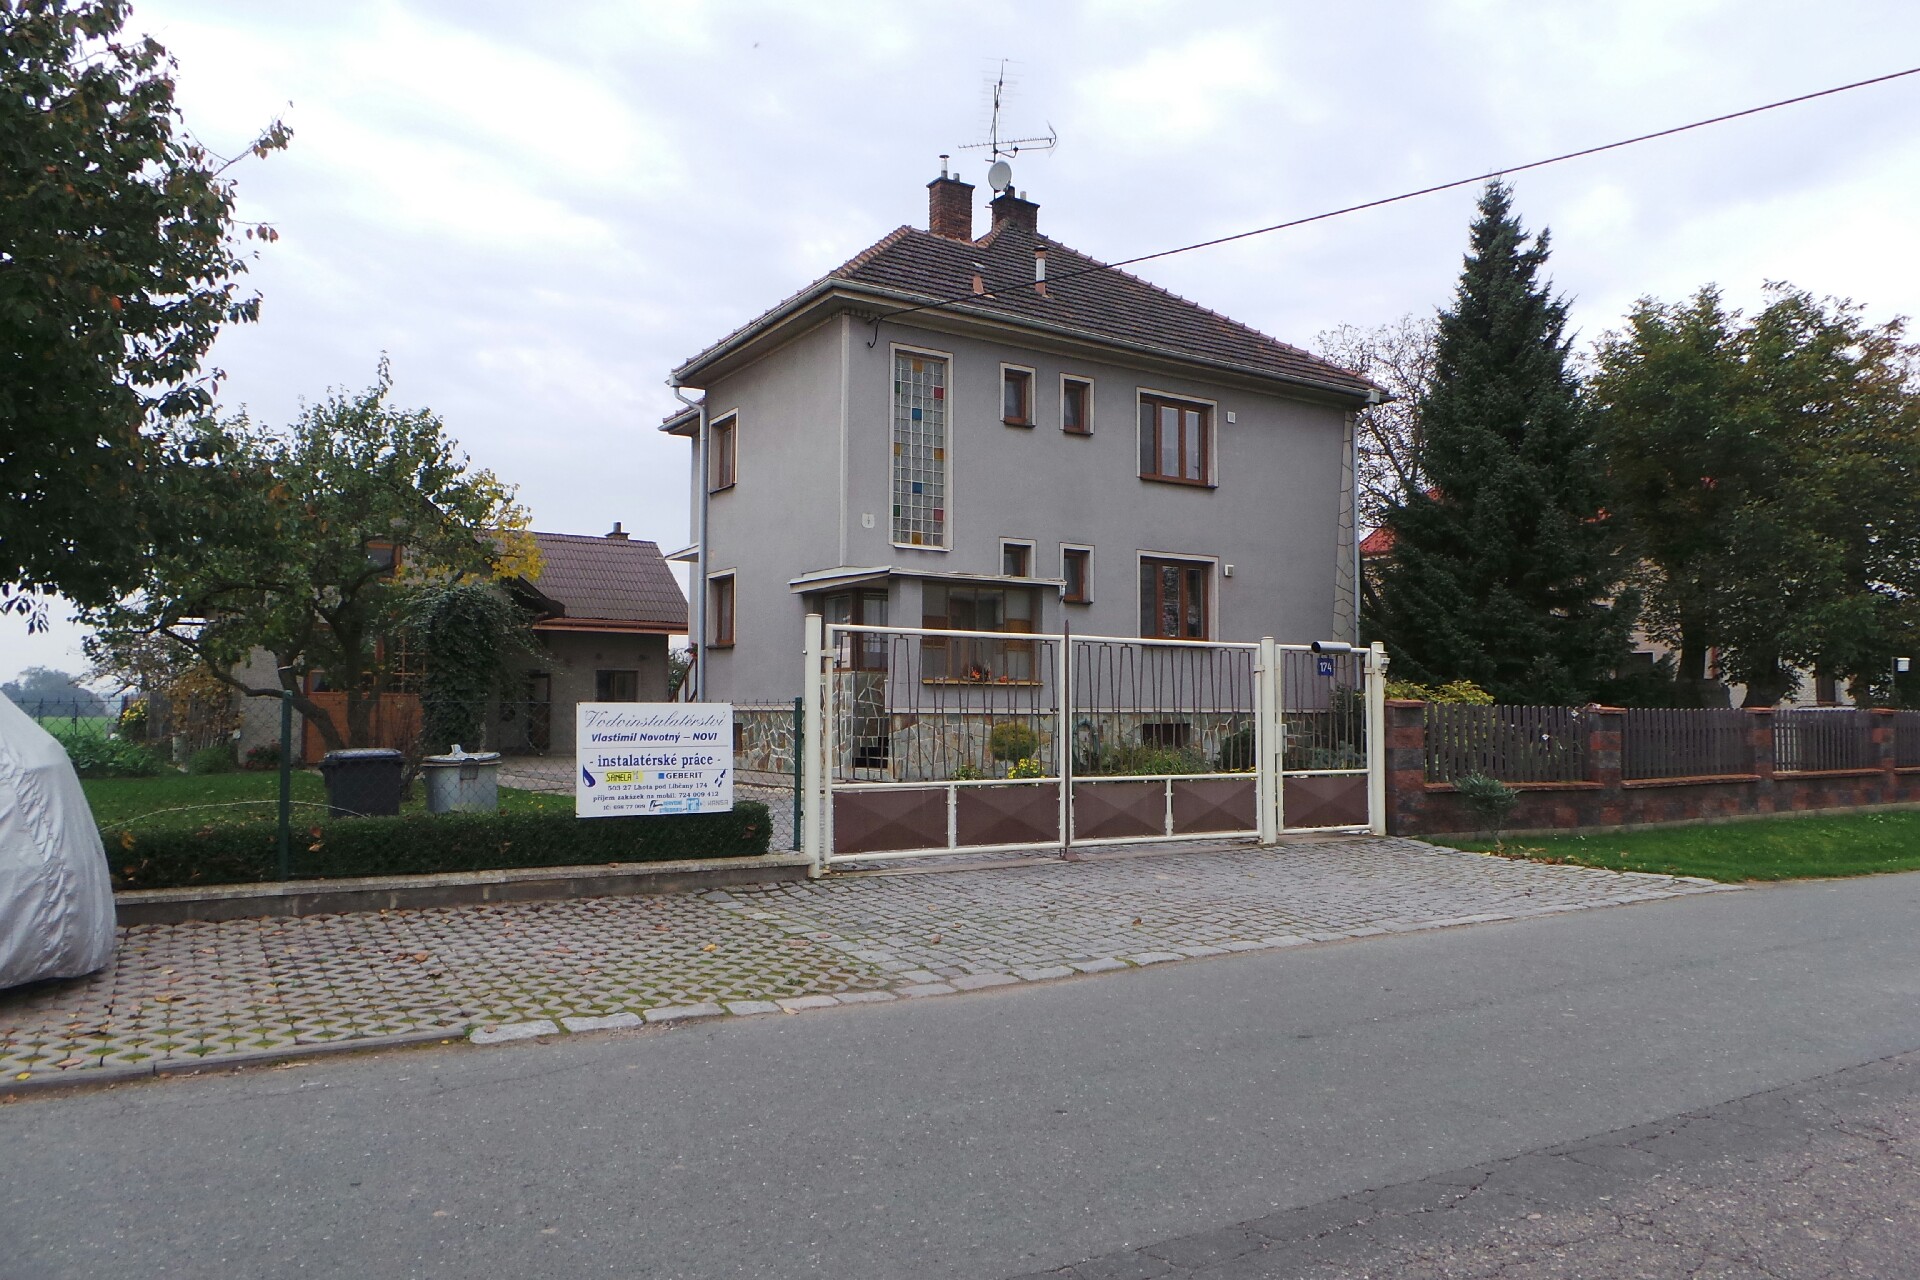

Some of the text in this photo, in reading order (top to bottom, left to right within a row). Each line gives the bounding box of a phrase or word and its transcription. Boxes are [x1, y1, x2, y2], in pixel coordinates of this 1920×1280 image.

[1319, 661, 1332, 673] 174
[591, 732, 638, 743] Vlastimil
[639, 730, 681, 743] Novotný
[692, 732, 718, 741] NOVI
[597, 753, 677, 767] instalatérské
[681, 752, 714, 768] práce
[606, 772, 632, 782] SANELA
[593, 795, 615, 803] příjem
